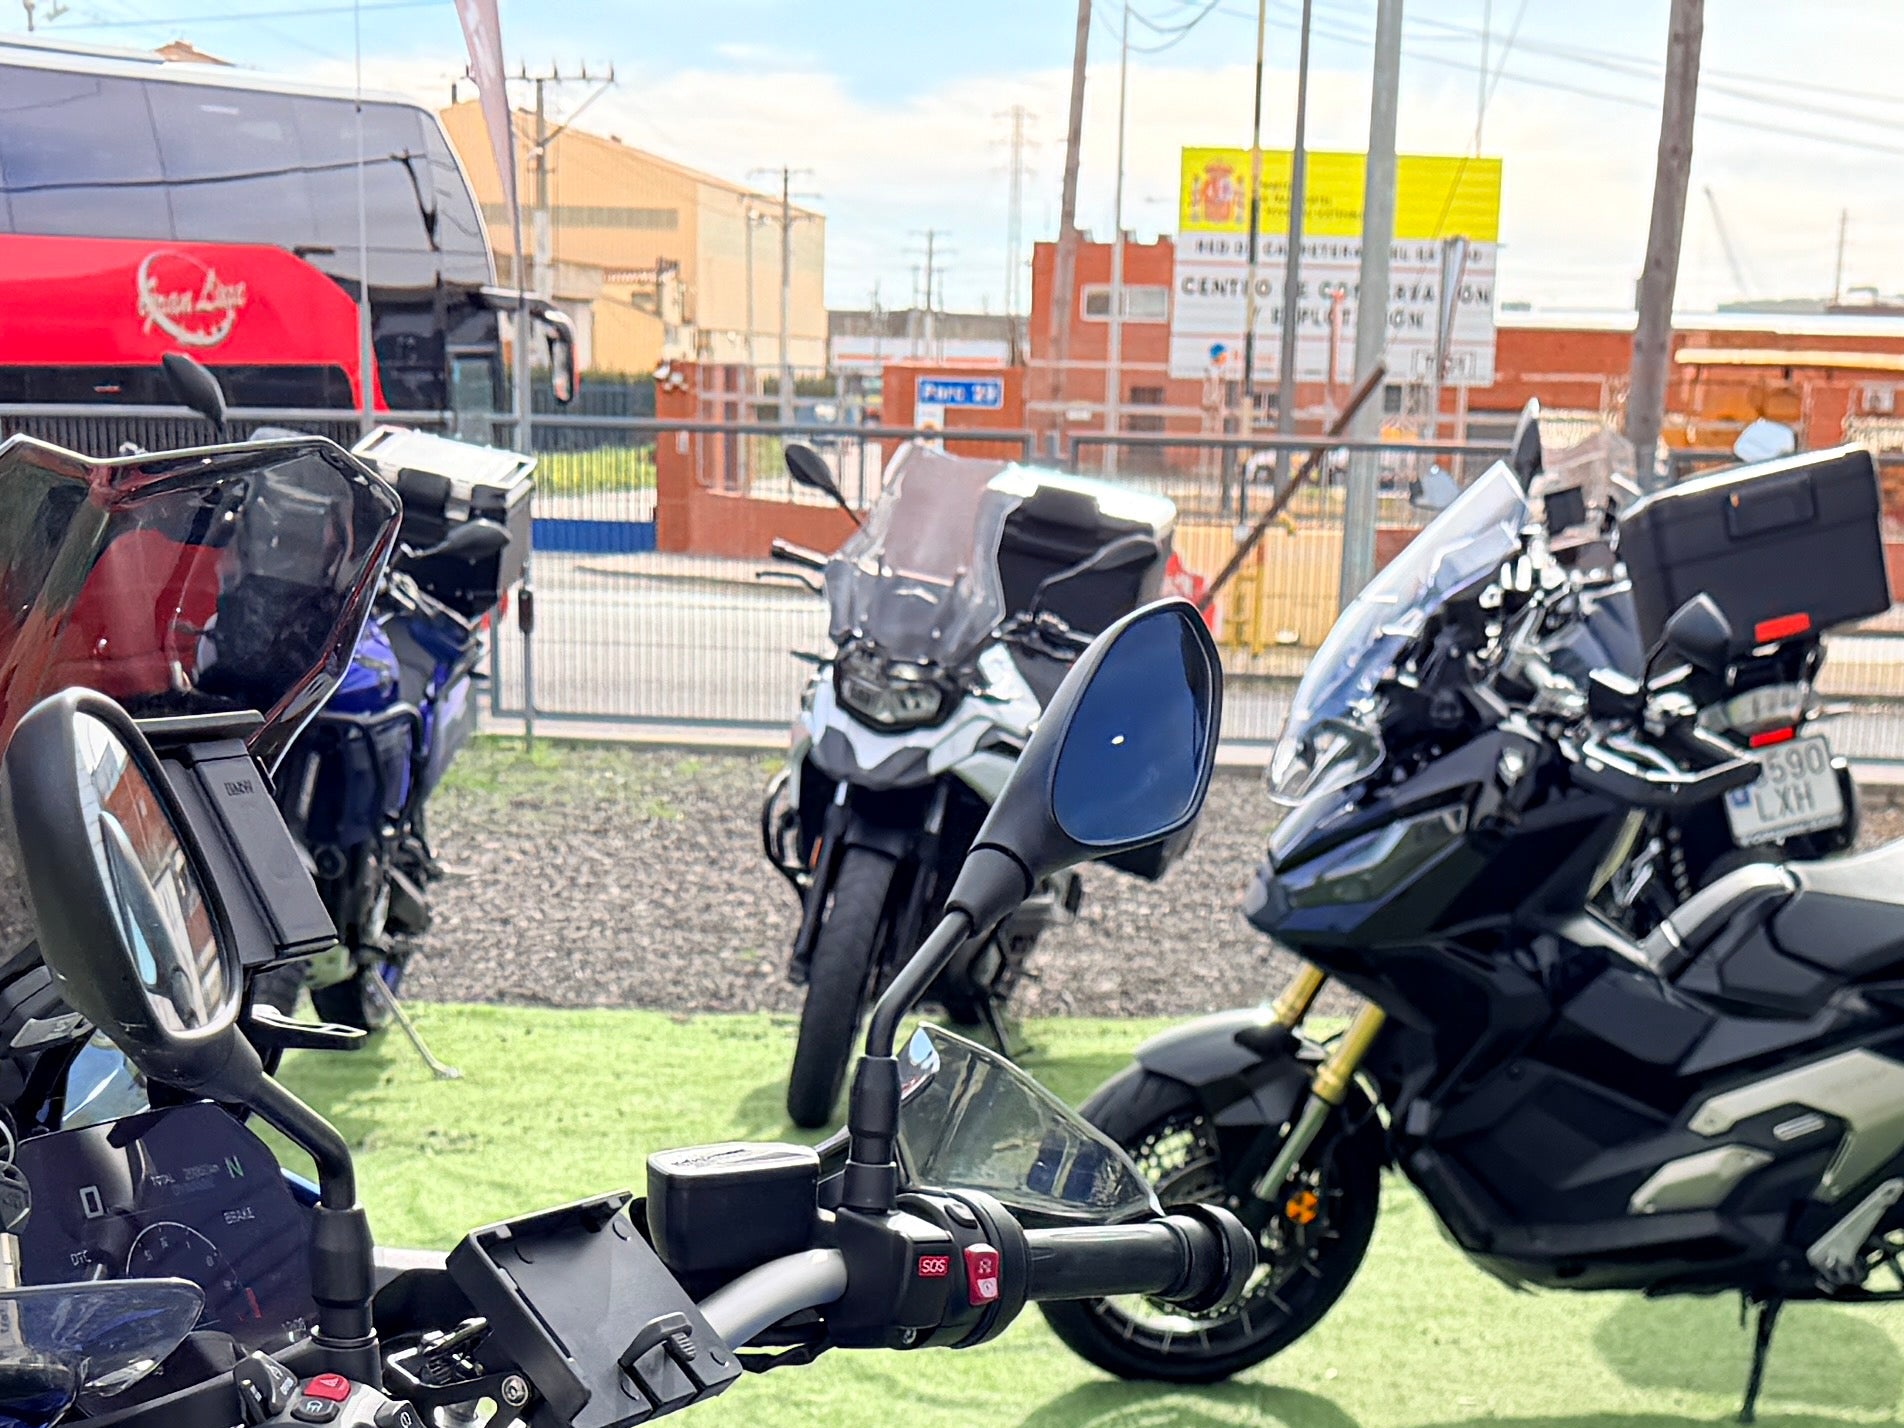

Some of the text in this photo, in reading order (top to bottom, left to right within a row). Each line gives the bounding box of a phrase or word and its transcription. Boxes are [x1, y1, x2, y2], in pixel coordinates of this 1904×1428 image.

[1753, 779, 1816, 823] LXH
[224, 1155, 244, 1179] N
[70, 1249, 93, 1267] DTC
[921, 1258, 947, 1274] SOS
